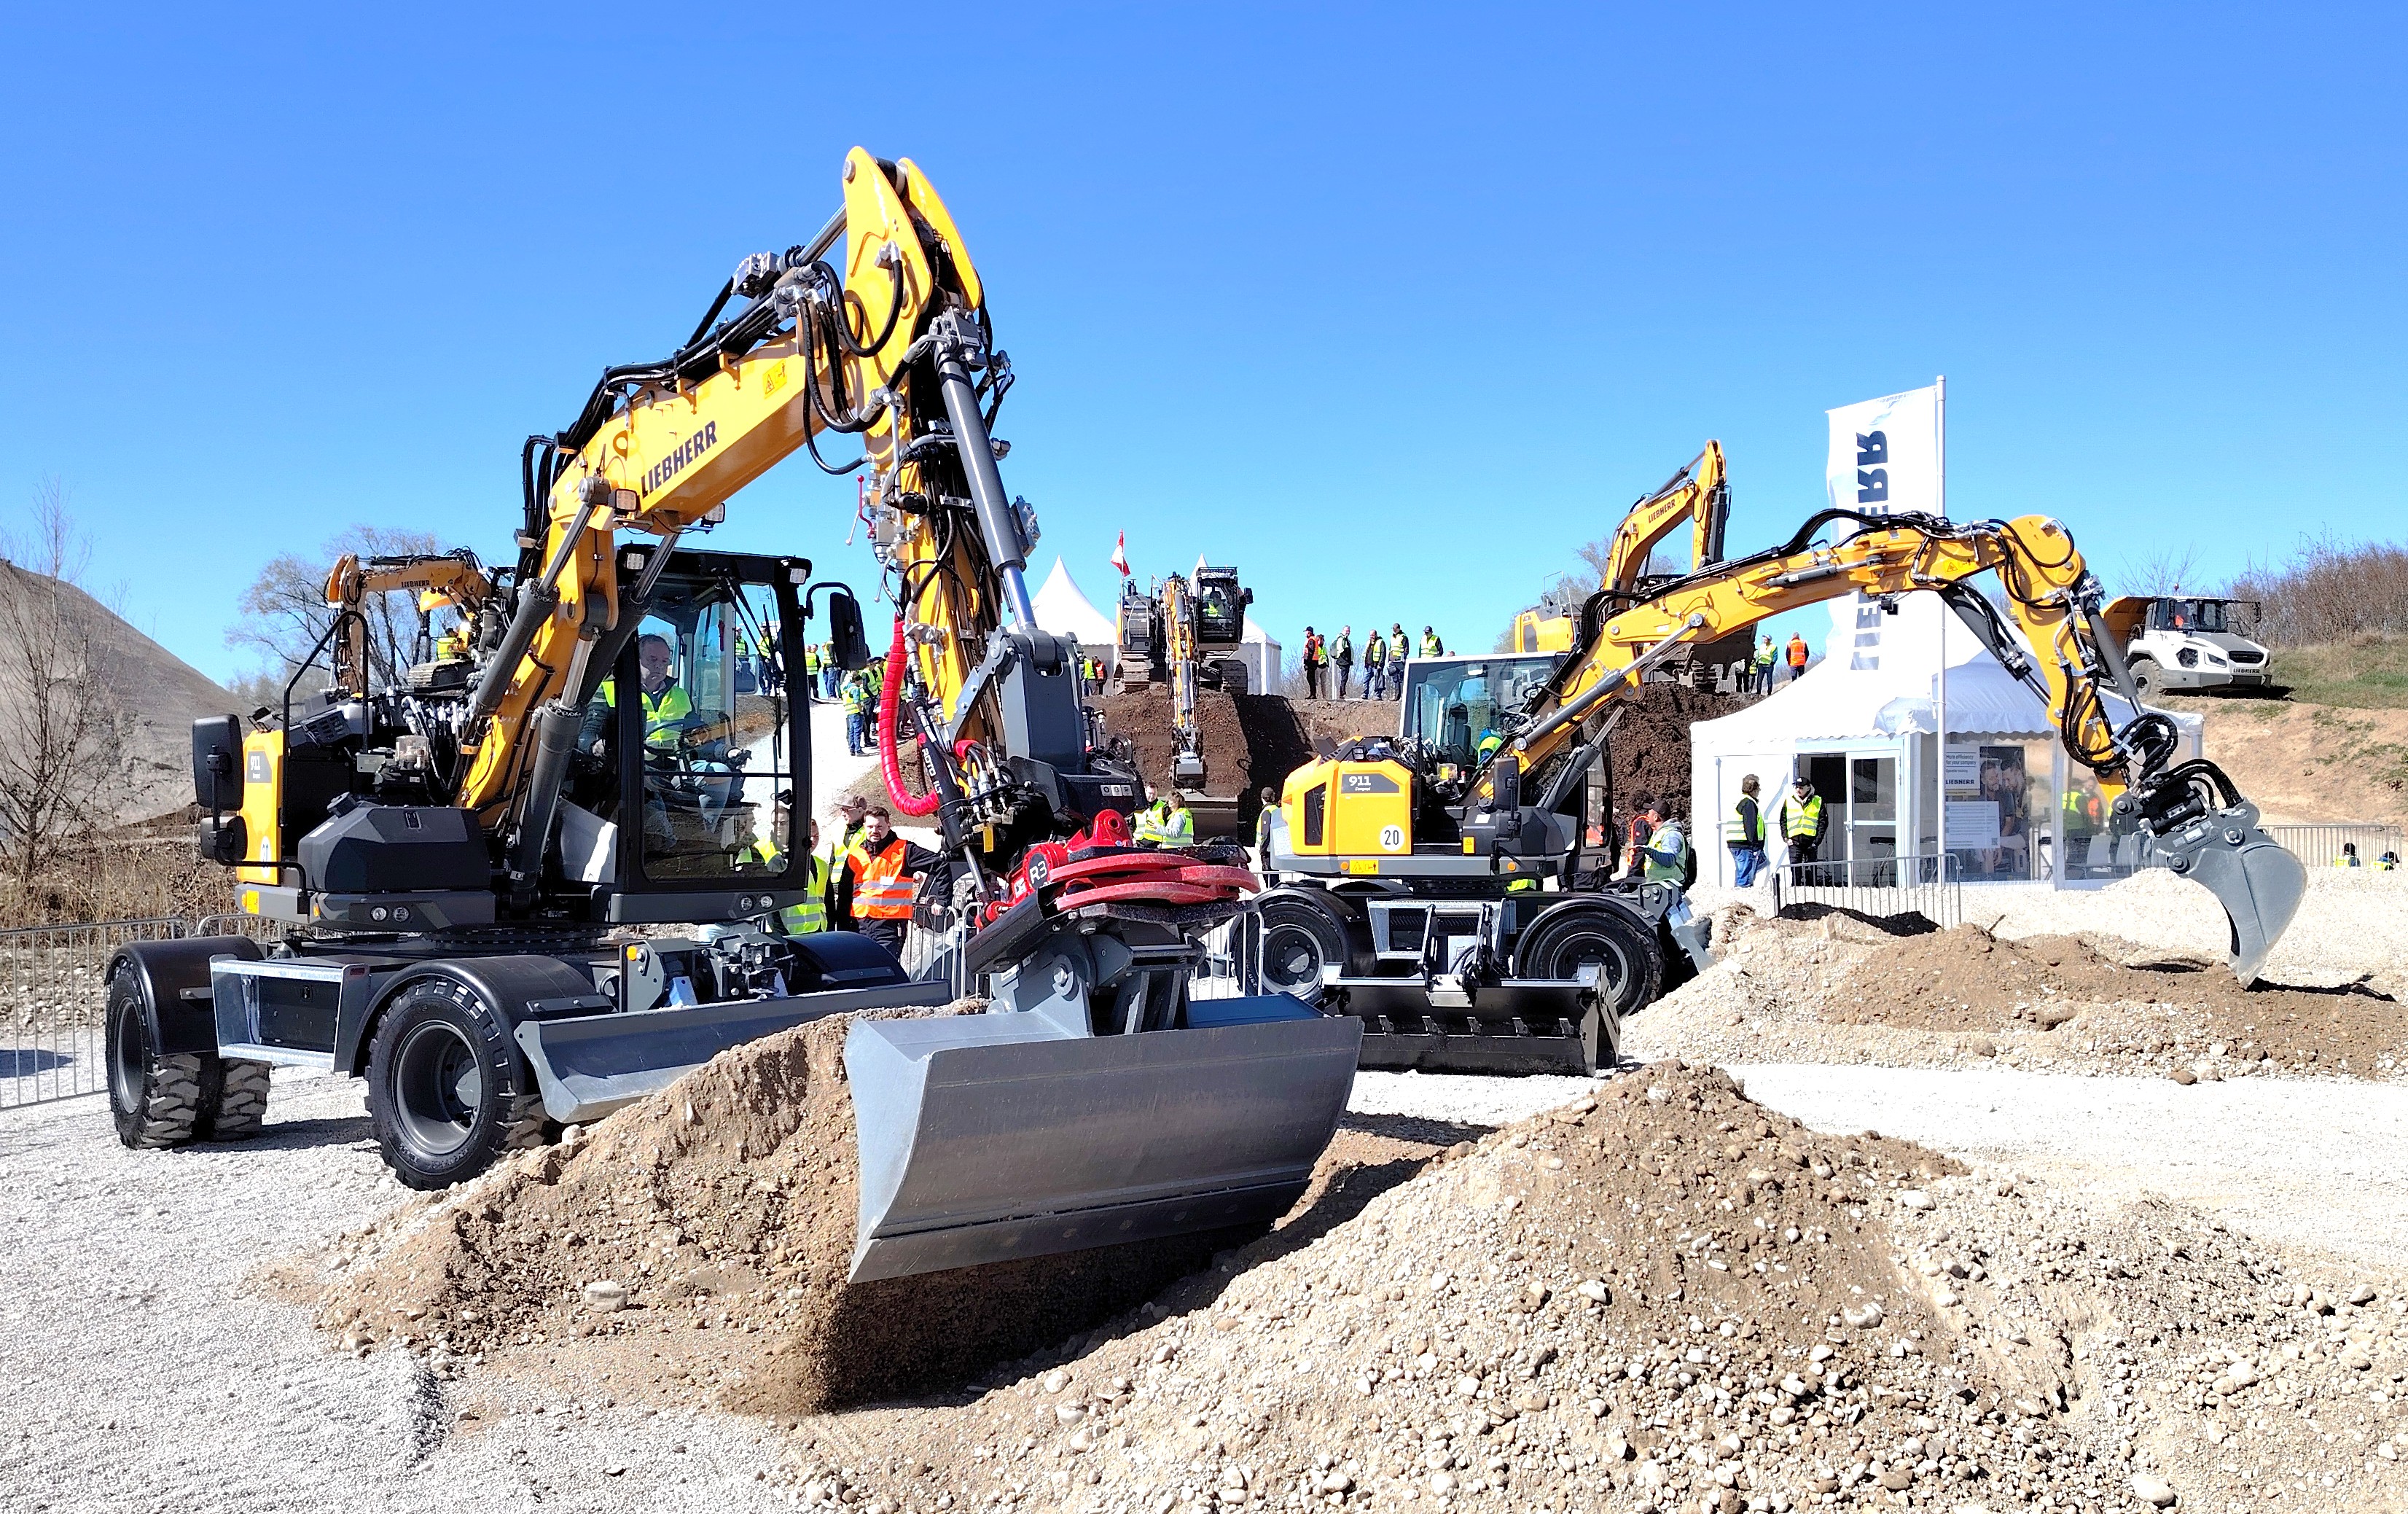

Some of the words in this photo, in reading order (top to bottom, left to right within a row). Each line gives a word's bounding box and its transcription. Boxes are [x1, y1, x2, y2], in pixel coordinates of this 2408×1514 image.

[641, 420, 718, 499] LIEBHERR
[1648, 499, 1676, 523] LIEBHERR
[1348, 776, 1372, 787] 911
[1384, 830, 1399, 846] 20
[1029, 860, 1047, 884] R3
